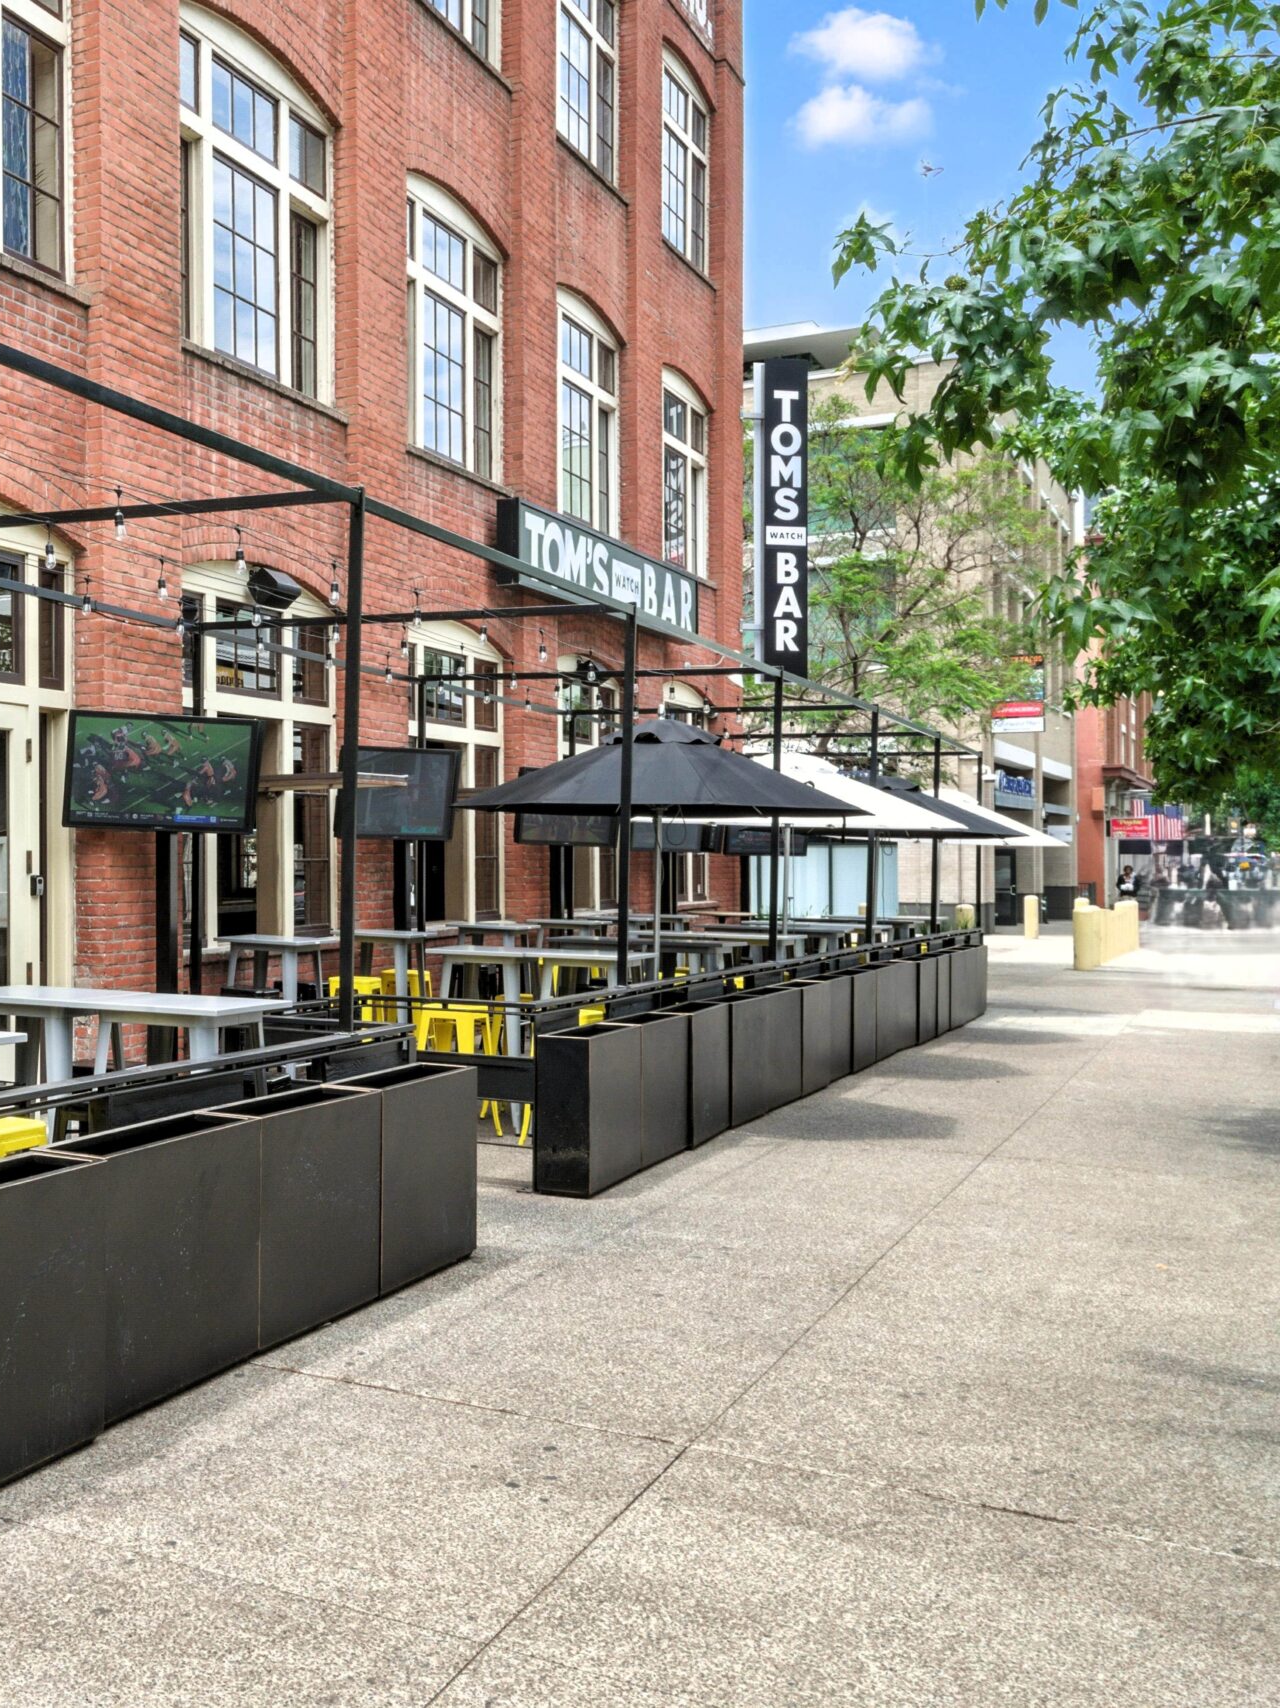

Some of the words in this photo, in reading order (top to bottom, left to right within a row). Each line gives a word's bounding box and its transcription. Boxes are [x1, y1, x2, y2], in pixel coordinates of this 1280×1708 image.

[770, 390, 802, 521] TOMS
[525, 512, 609, 597] TOM'S
[615, 573, 639, 595] WATCH
[644, 563, 692, 633] BAR
[770, 532, 803, 540] WATCH
[773, 552, 803, 651] BAR
